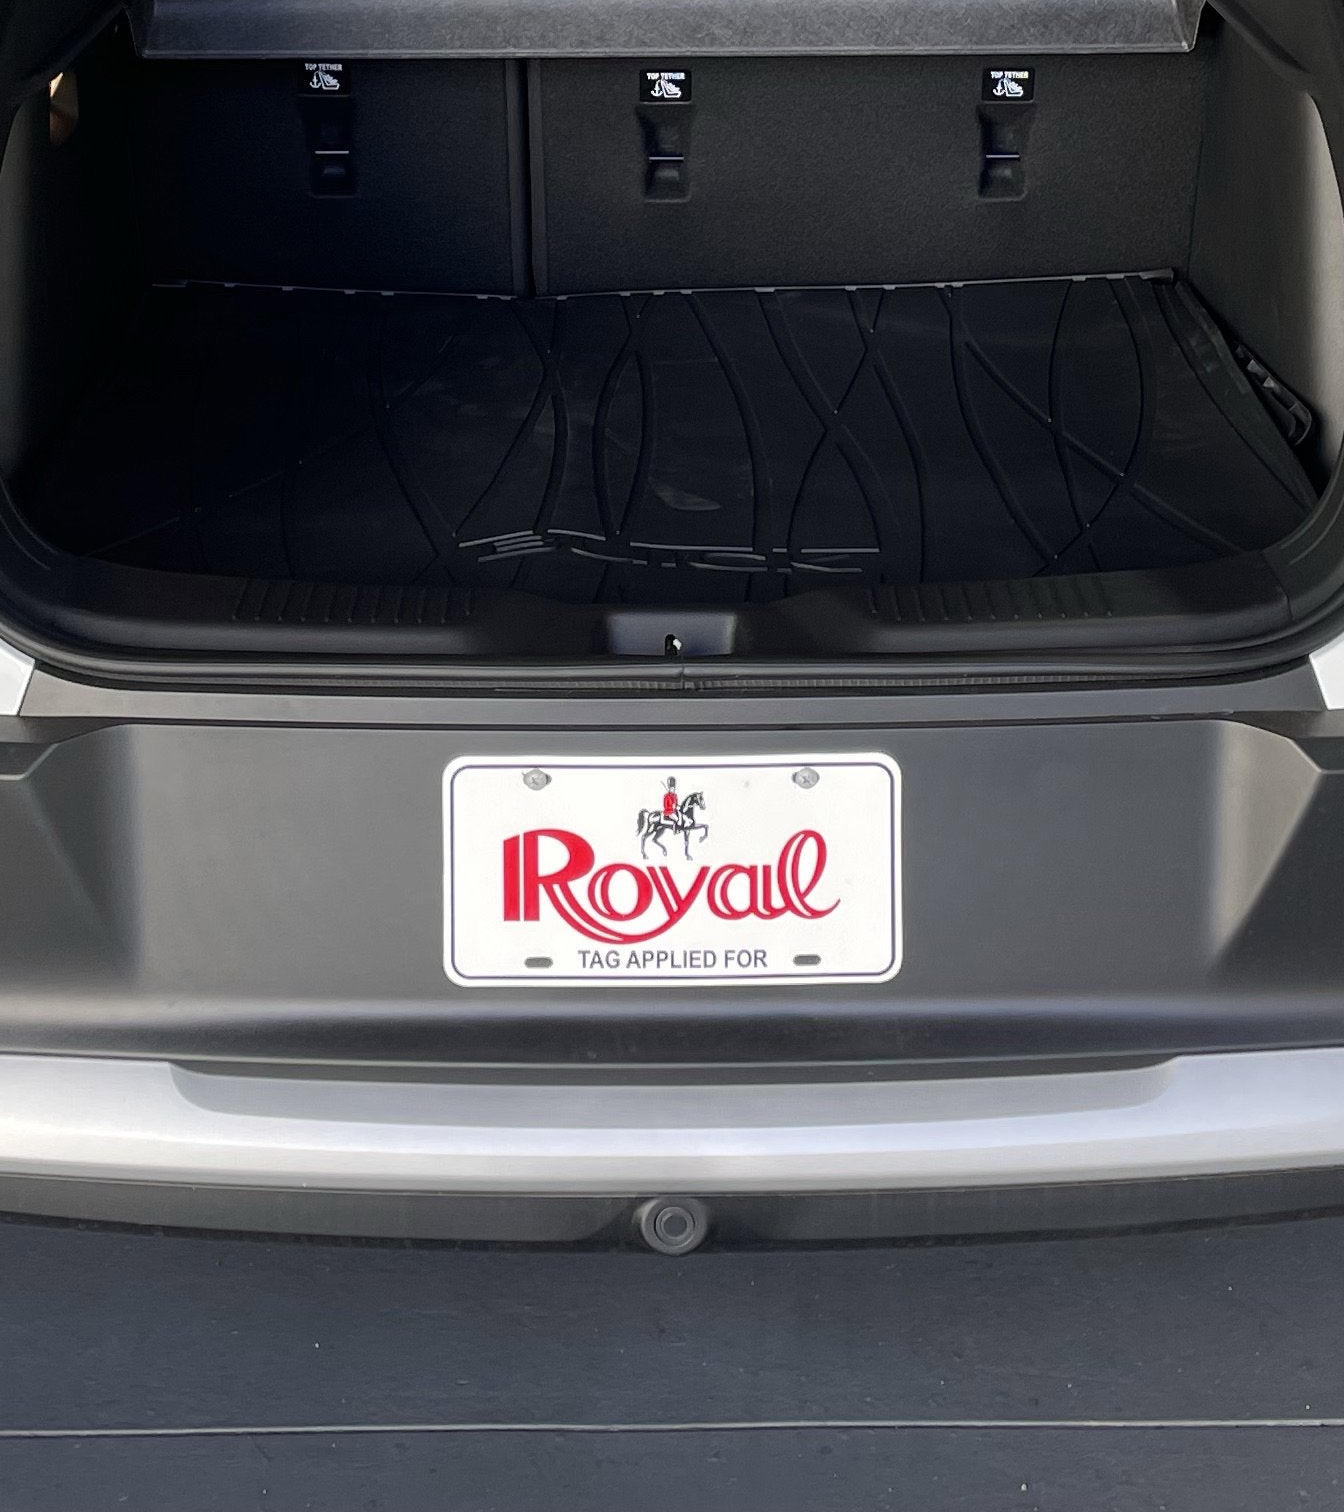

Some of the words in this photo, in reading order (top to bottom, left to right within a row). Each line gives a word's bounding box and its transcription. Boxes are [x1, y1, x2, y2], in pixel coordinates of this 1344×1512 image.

[305, 63, 317, 71] TOP
[318, 63, 343, 71] TETHER
[647, 72, 659, 80] TOP
[660, 72, 685, 80] TETHER
[991, 70, 1004, 79] TOP
[1004, 70, 1029, 79] TETHER
[502, 828, 841, 944] Royal
[577, 949, 621, 969] TAG
[625, 949, 717, 969] APPLIED
[724, 948, 768, 968] FOR
